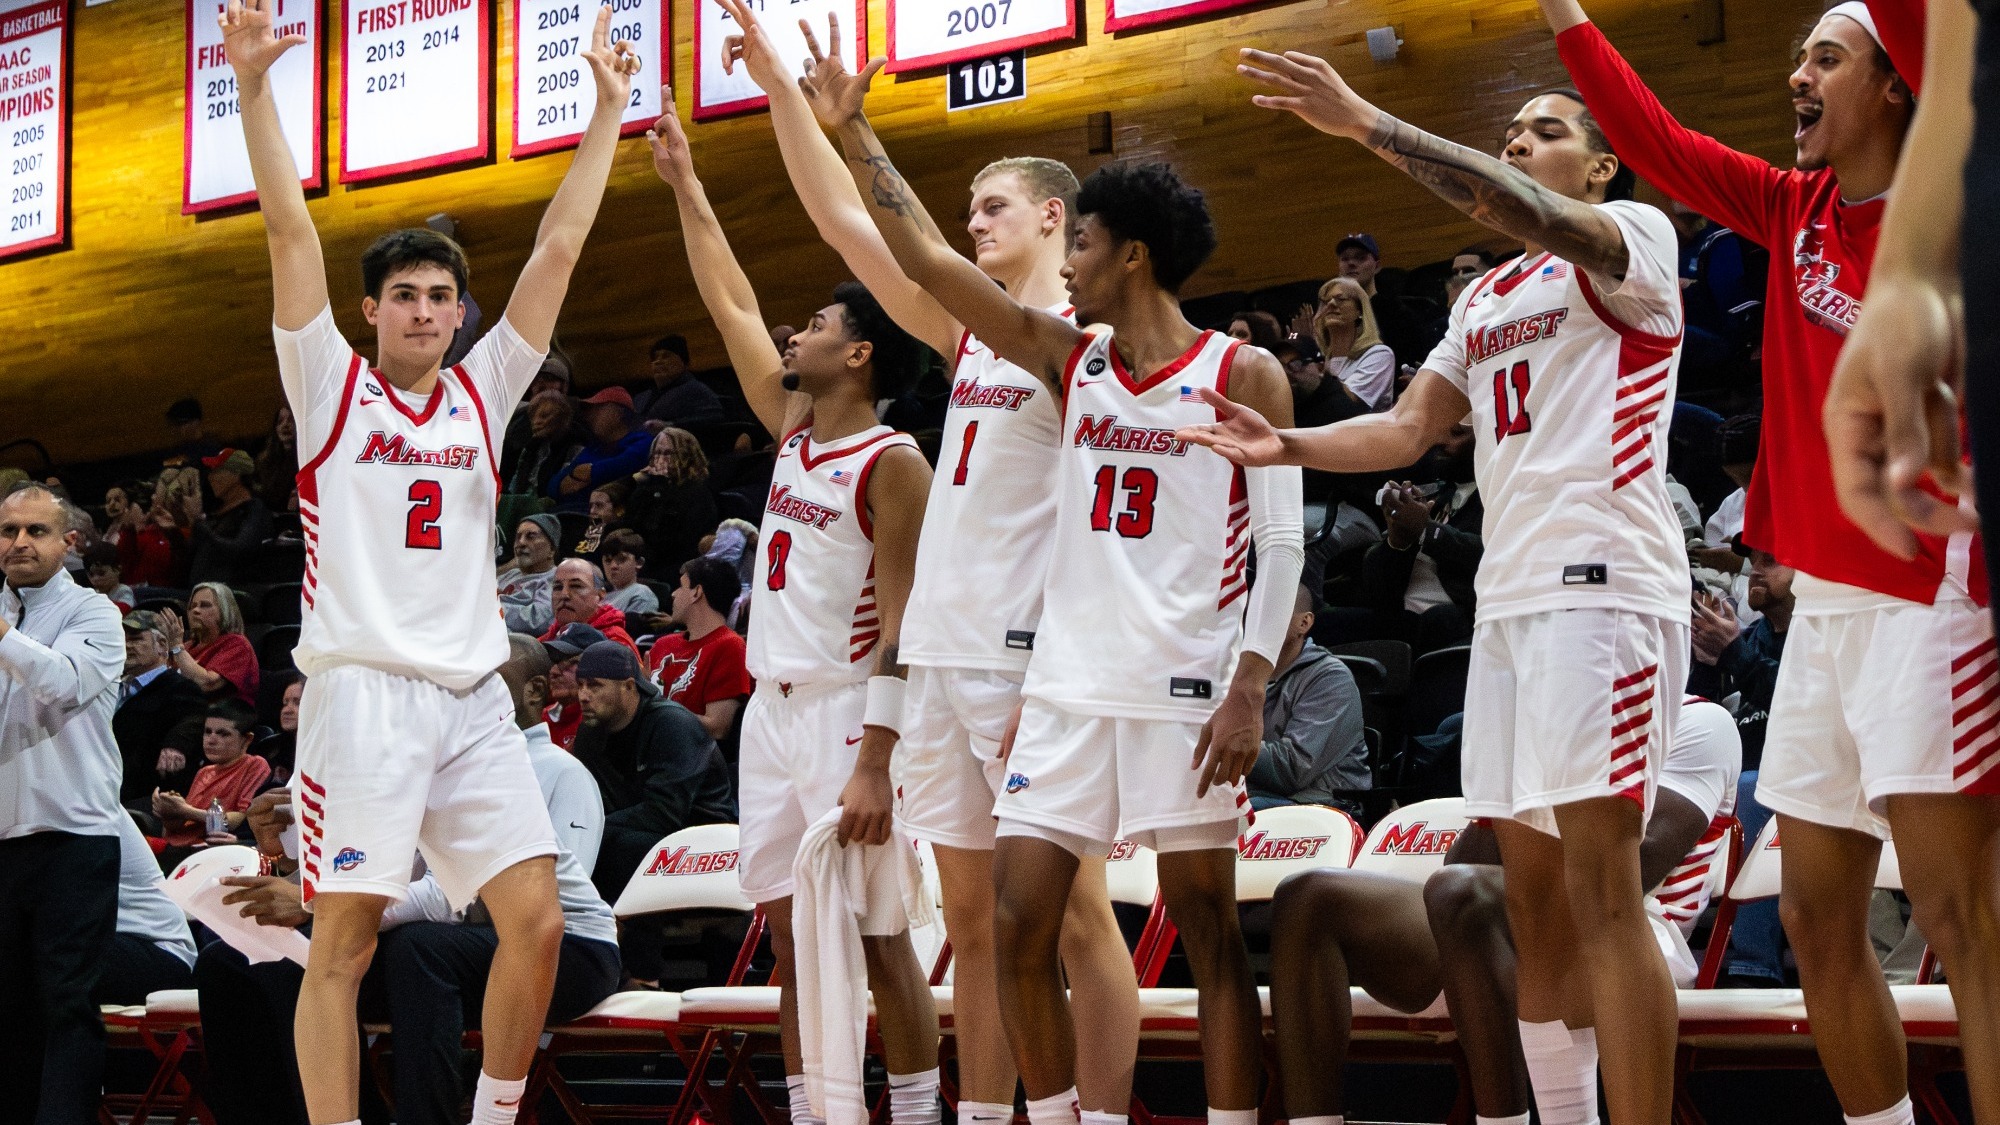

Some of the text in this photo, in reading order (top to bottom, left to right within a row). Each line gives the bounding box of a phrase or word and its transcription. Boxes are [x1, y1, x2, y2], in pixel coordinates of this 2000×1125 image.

[3, 5, 62, 38] BASKETBALL
[357, 2, 407, 35] FIRST
[538, 4, 580, 30] 2004
[947, 0, 1012, 37] 2007
[198, 43, 226, 70] FIR
[366, 25, 459, 63] 2013 2014
[537, 22, 642, 62] 2007 008
[12, 65, 51, 91] SEASON
[207, 77, 239, 98] 201
[366, 71, 406, 93] 2021
[537, 69, 579, 94] 2009
[960, 56, 1015, 101] 103
[537, 101, 577, 126] 2011
[13, 124, 45, 147] 2005
[13, 153, 43, 175] 2007
[12, 182, 43, 204] 2009
[11, 210, 41, 232] 2011
[1465, 307, 1569, 370] MARIST
[950, 377, 1035, 411] MARIST
[1493, 359, 1531, 445] 11
[355, 430, 479, 470] MARIST
[953, 420, 979, 486] 1
[405, 479, 443, 550] 2
[766, 482, 842, 531] MARIST
[1090, 464, 1158, 539] 13
[767, 529, 792, 591] 0
[1237, 830, 1331, 860] MARIST
[1371, 818, 1463, 855] MAR
[643, 845, 739, 876] MARIST
